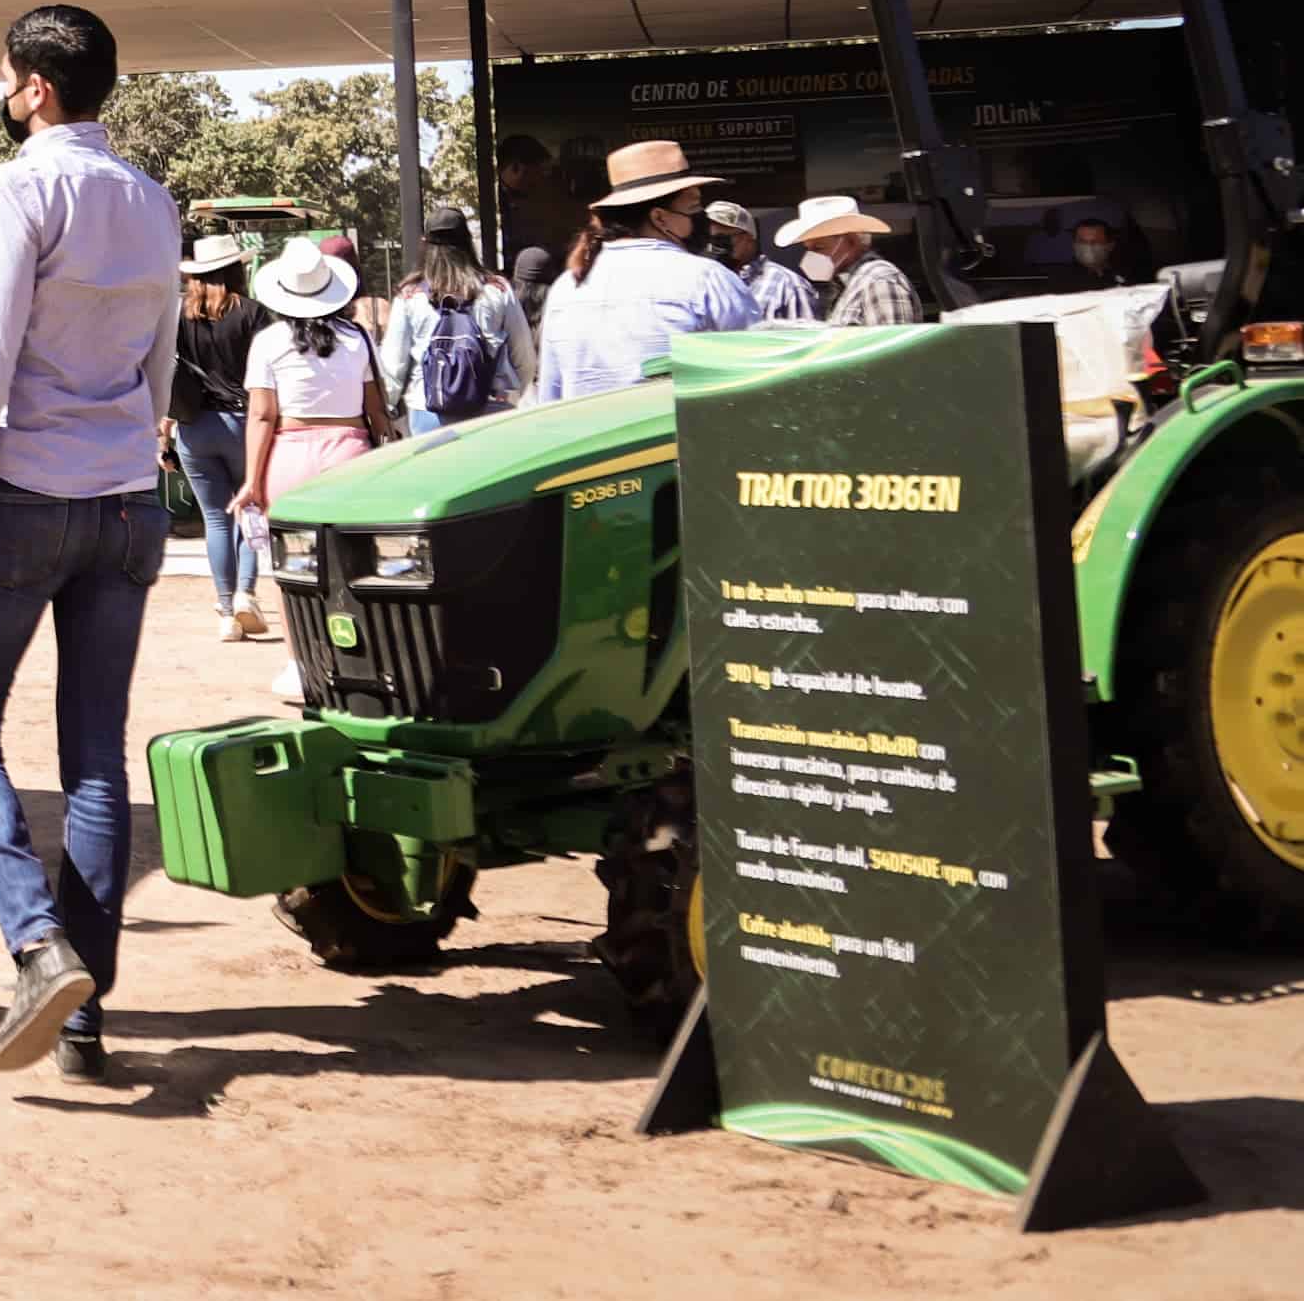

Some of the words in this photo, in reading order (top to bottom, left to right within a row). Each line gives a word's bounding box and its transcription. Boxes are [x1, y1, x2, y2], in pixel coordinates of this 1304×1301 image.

[631, 82, 700, 103] CENTRO
[707, 80, 729, 98] DE
[736, 71, 848, 96] SOLUCIONES
[571, 483, 617, 510] 3036
[619, 477, 642, 496] EN
[736, 472, 852, 508] TRACTOR
[853, 474, 961, 511] 3036EN
[746, 581, 763, 601] de
[764, 583, 803, 603] ancho
[855, 592, 887, 613] para
[888, 589, 940, 612] cultivos
[941, 597, 969, 615] con
[722, 608, 759, 629] calles
[752, 665, 770, 690] kg
[771, 666, 789, 687] de
[789, 671, 853, 694] capacidad
[855, 673, 872, 694] de
[728, 717, 806, 745] Transmisión
[806, 729, 868, 752] mecánica
[918, 744, 946, 761] con
[732, 773, 791, 799] dirección
[833, 791, 843, 812] y
[846, 764, 878, 785] para
[879, 764, 935, 789] cambios
[936, 768, 957, 793] de
[734, 828, 770, 853] Toma
[771, 834, 788, 855] de
[978, 870, 1008, 890] con
[736, 859, 774, 881] modo
[739, 912, 777, 938] Cofre
[777, 919, 832, 948] abatible
[832, 934, 864, 955] para
[865, 940, 883, 957] un
[883, 936, 915, 963] fácil
